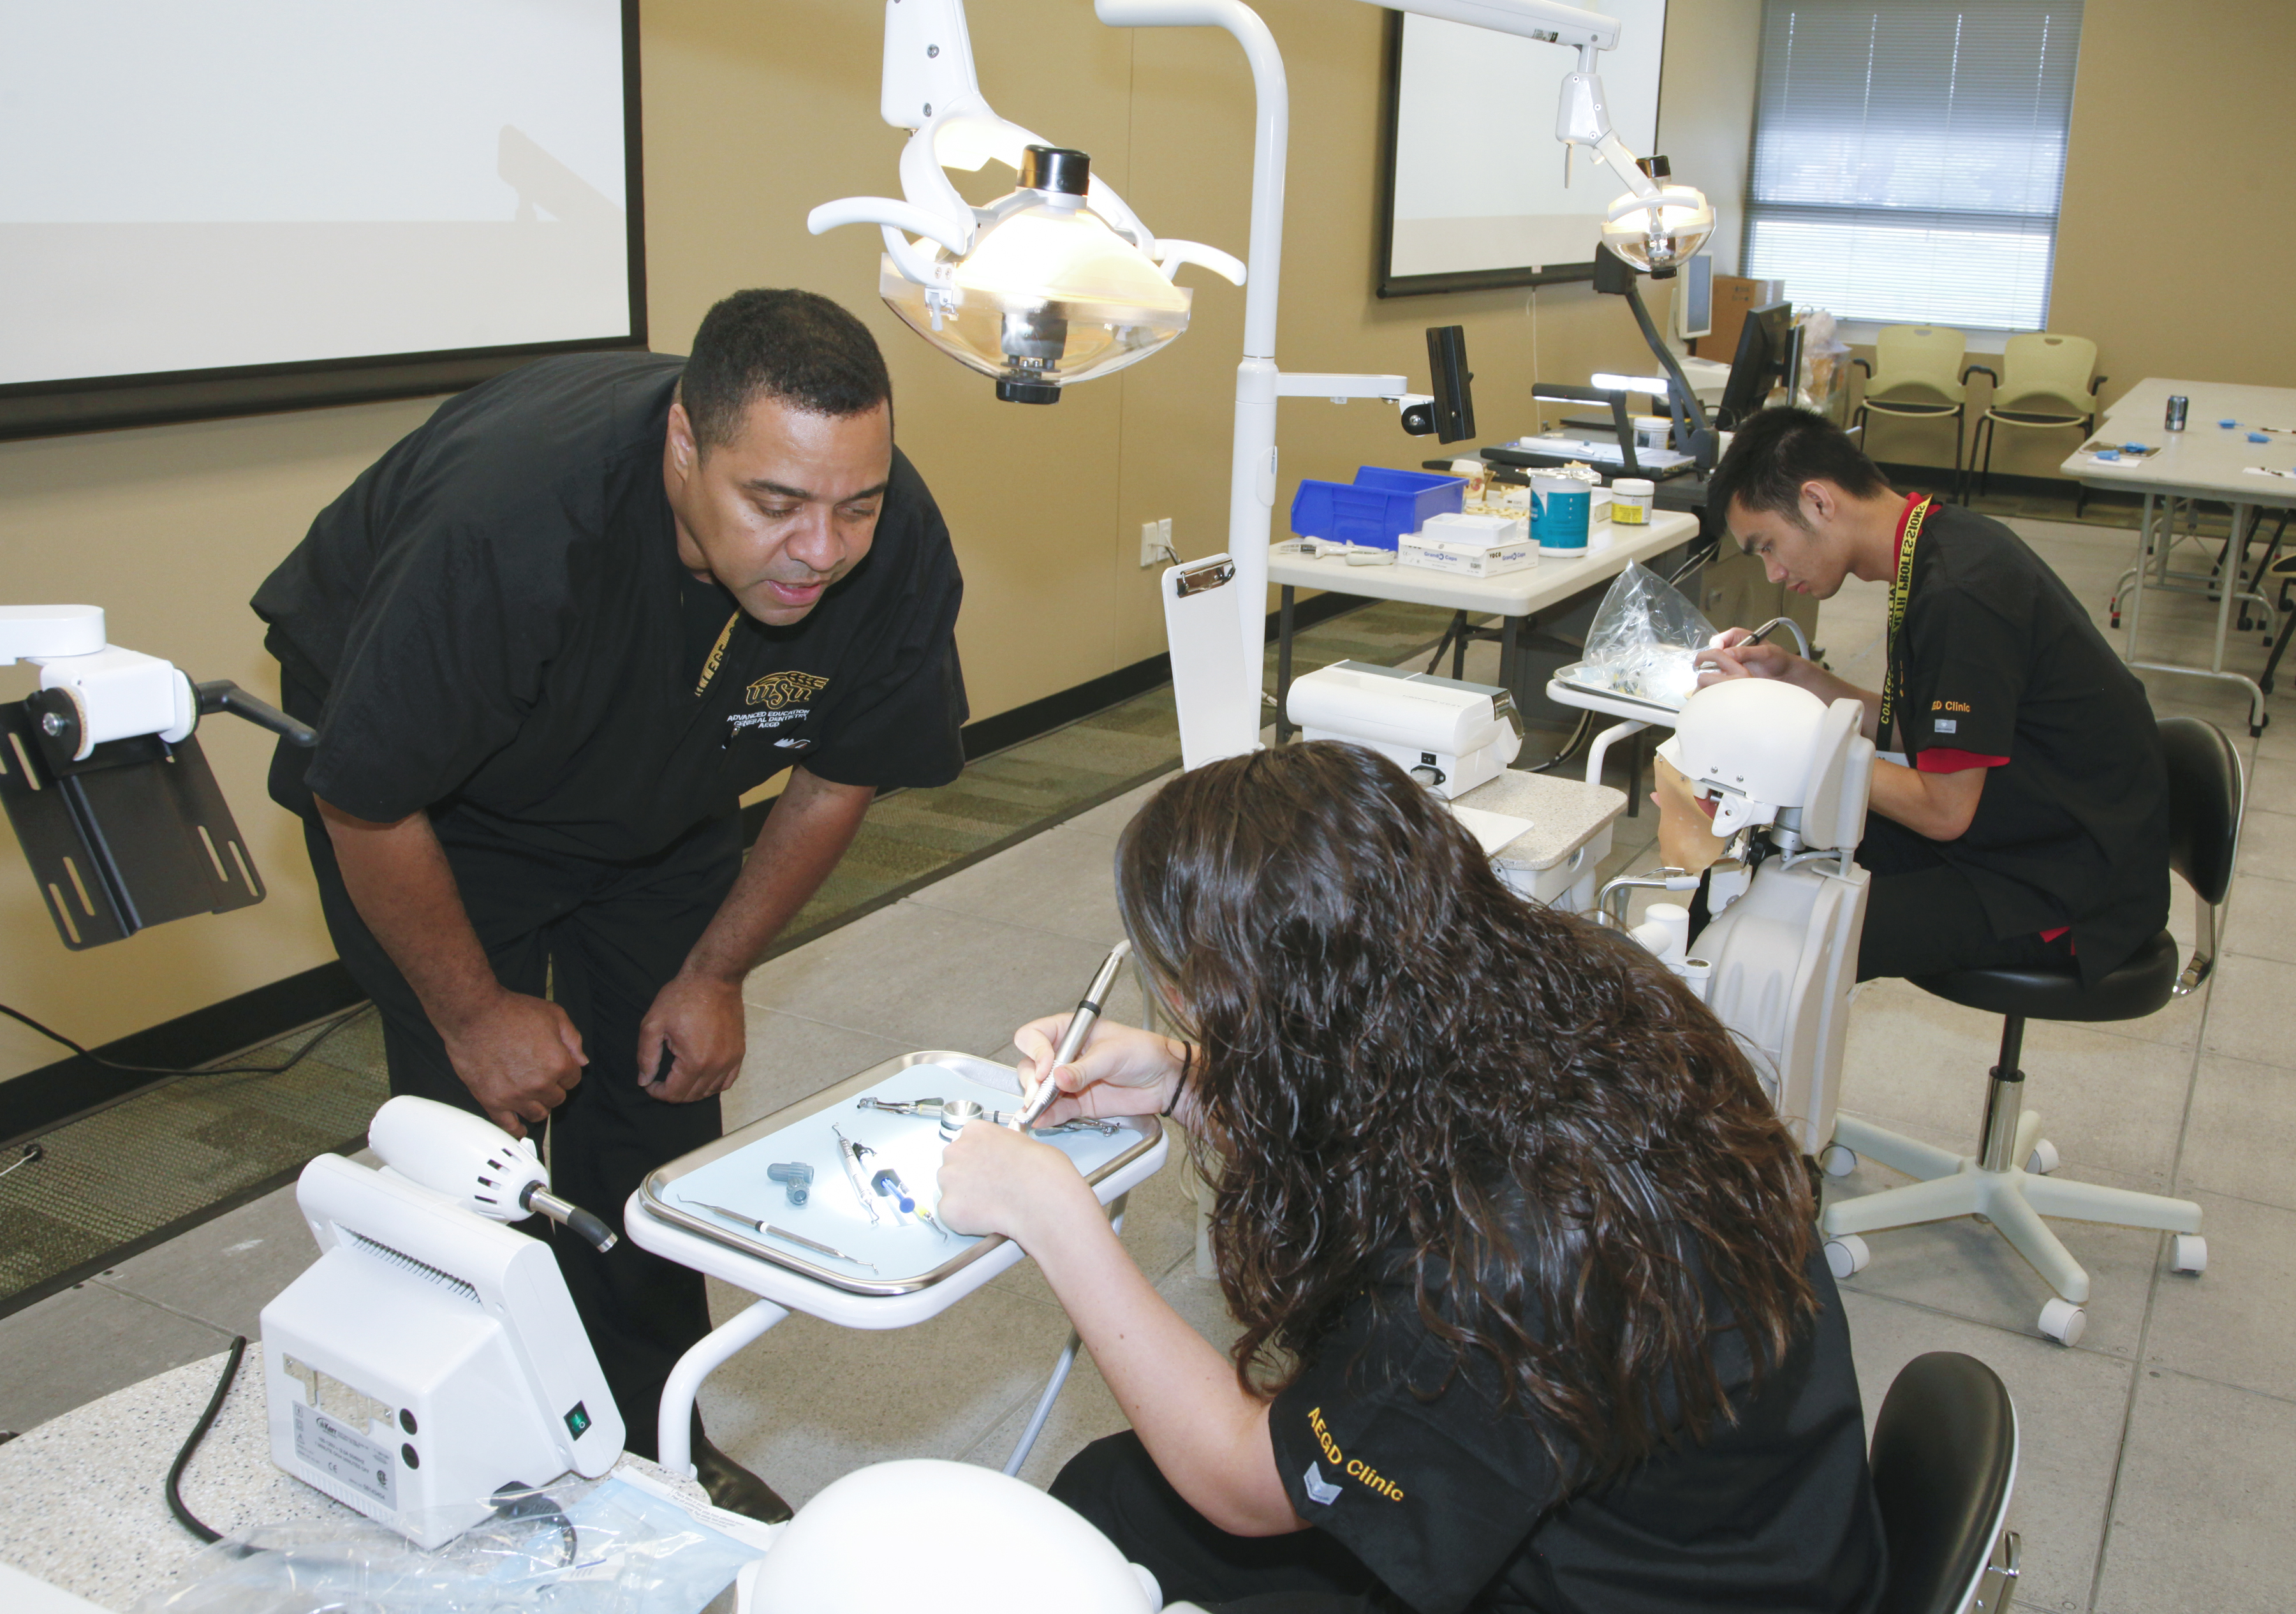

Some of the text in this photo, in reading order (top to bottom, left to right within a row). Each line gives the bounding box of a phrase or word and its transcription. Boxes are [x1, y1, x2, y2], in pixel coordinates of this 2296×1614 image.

[1945, 701, 1971, 713] Clinic
[726, 711, 767, 722] ADVANCED
[733, 713, 807, 727] GENERAL DENTISTRY
[1307, 1407, 1343, 1465] AEGD
[1346, 1460, 1404, 1502] Clinic
